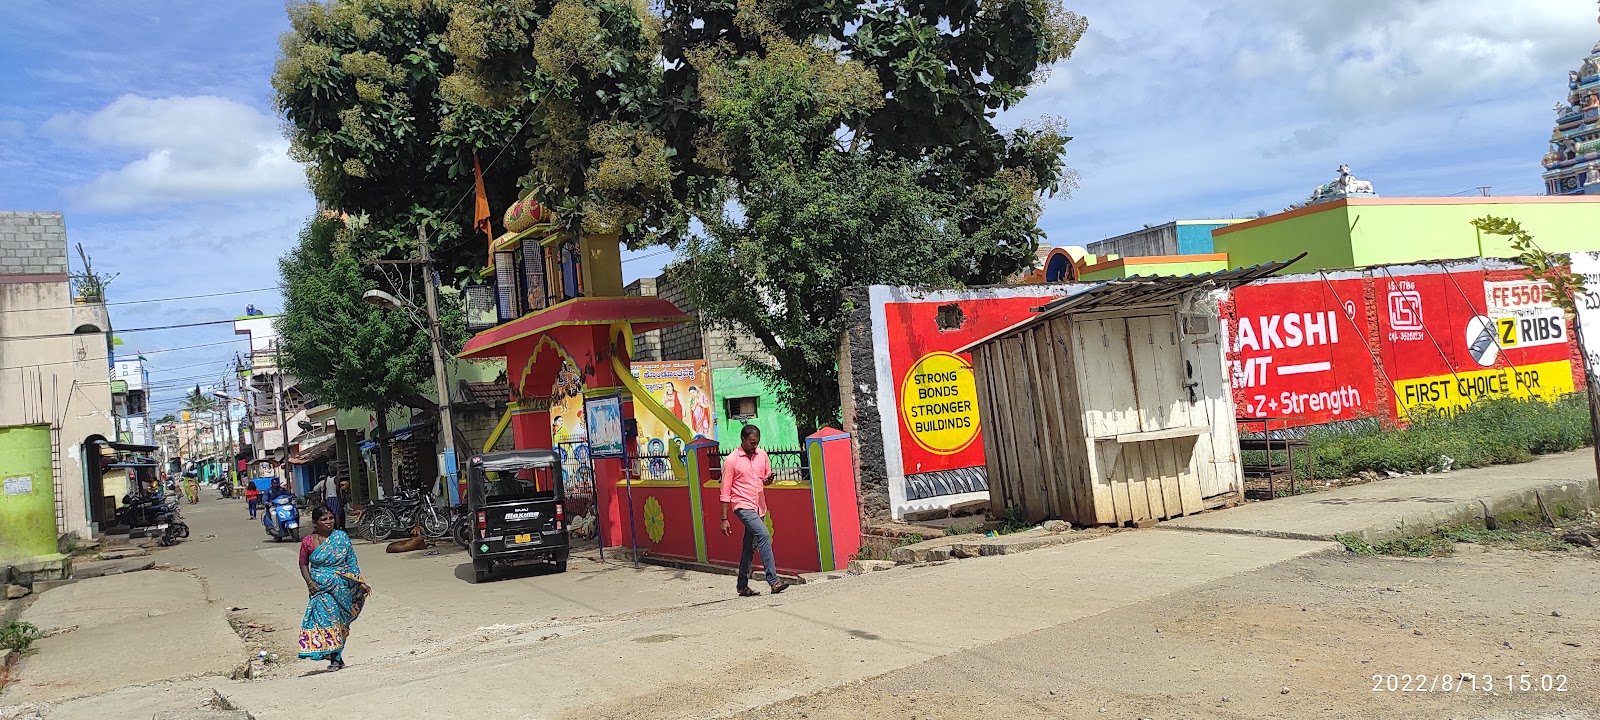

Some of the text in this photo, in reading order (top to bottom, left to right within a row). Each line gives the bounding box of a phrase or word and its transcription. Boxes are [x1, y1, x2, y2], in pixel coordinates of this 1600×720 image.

[1501, 316, 1562, 345] Z RIBS
[914, 371, 957, 385] STRONG
[1405, 370, 1541, 404] FIRST CHOICE FOR
[918, 386, 959, 399] BONDS
[1280, 385, 1361, 415] Strength
[911, 400, 972, 418] STRONGER
[915, 416, 971, 433] BUILDINDS
